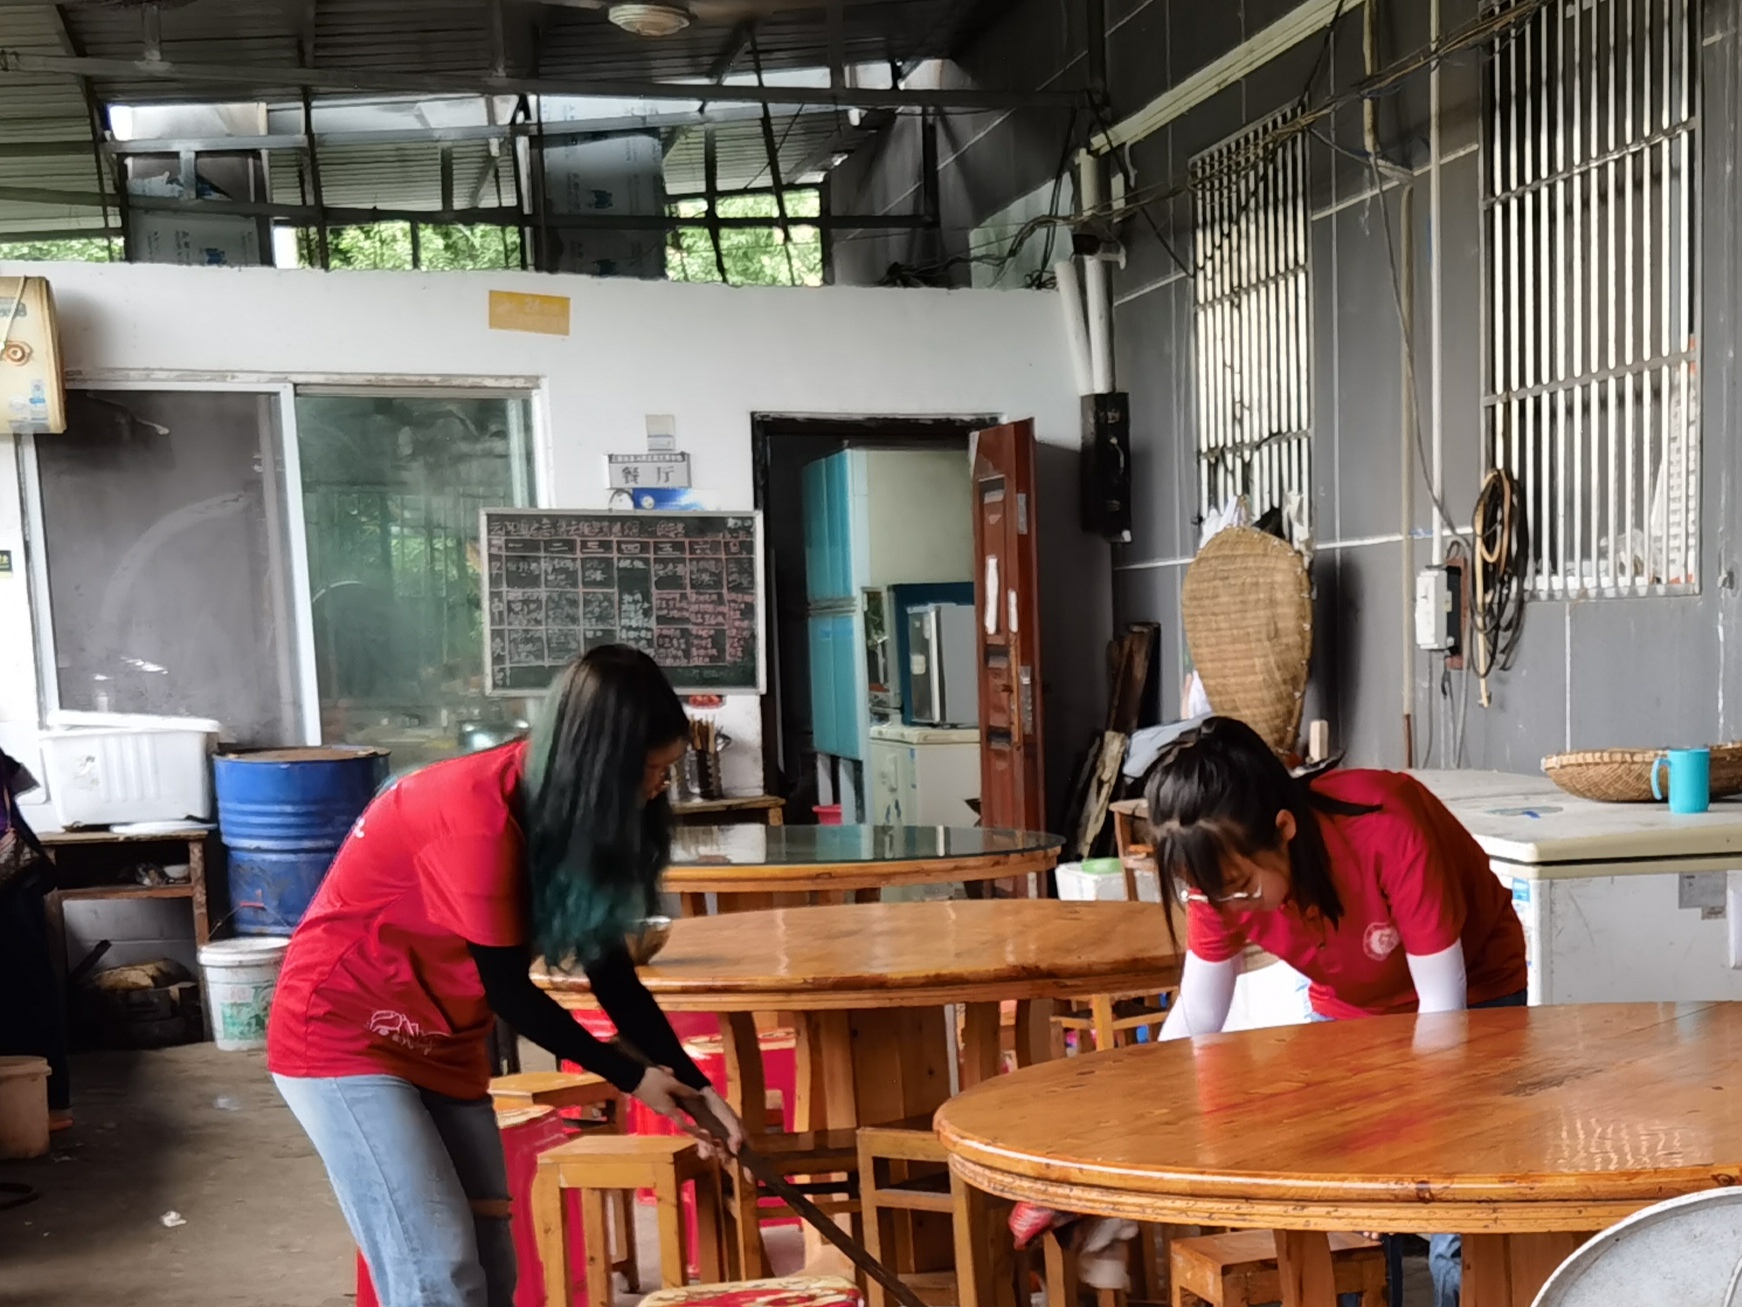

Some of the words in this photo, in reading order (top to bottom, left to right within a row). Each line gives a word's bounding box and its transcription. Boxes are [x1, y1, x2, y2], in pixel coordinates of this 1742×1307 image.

[621, 466, 675, 484] 餐厅
[548, 542, 569, 551] 二
[582, 541, 604, 552] 三
[621, 543, 641, 554] 四
[657, 543, 680, 555] 五
[694, 540, 712, 554] 六
[491, 597, 504, 625] 中
